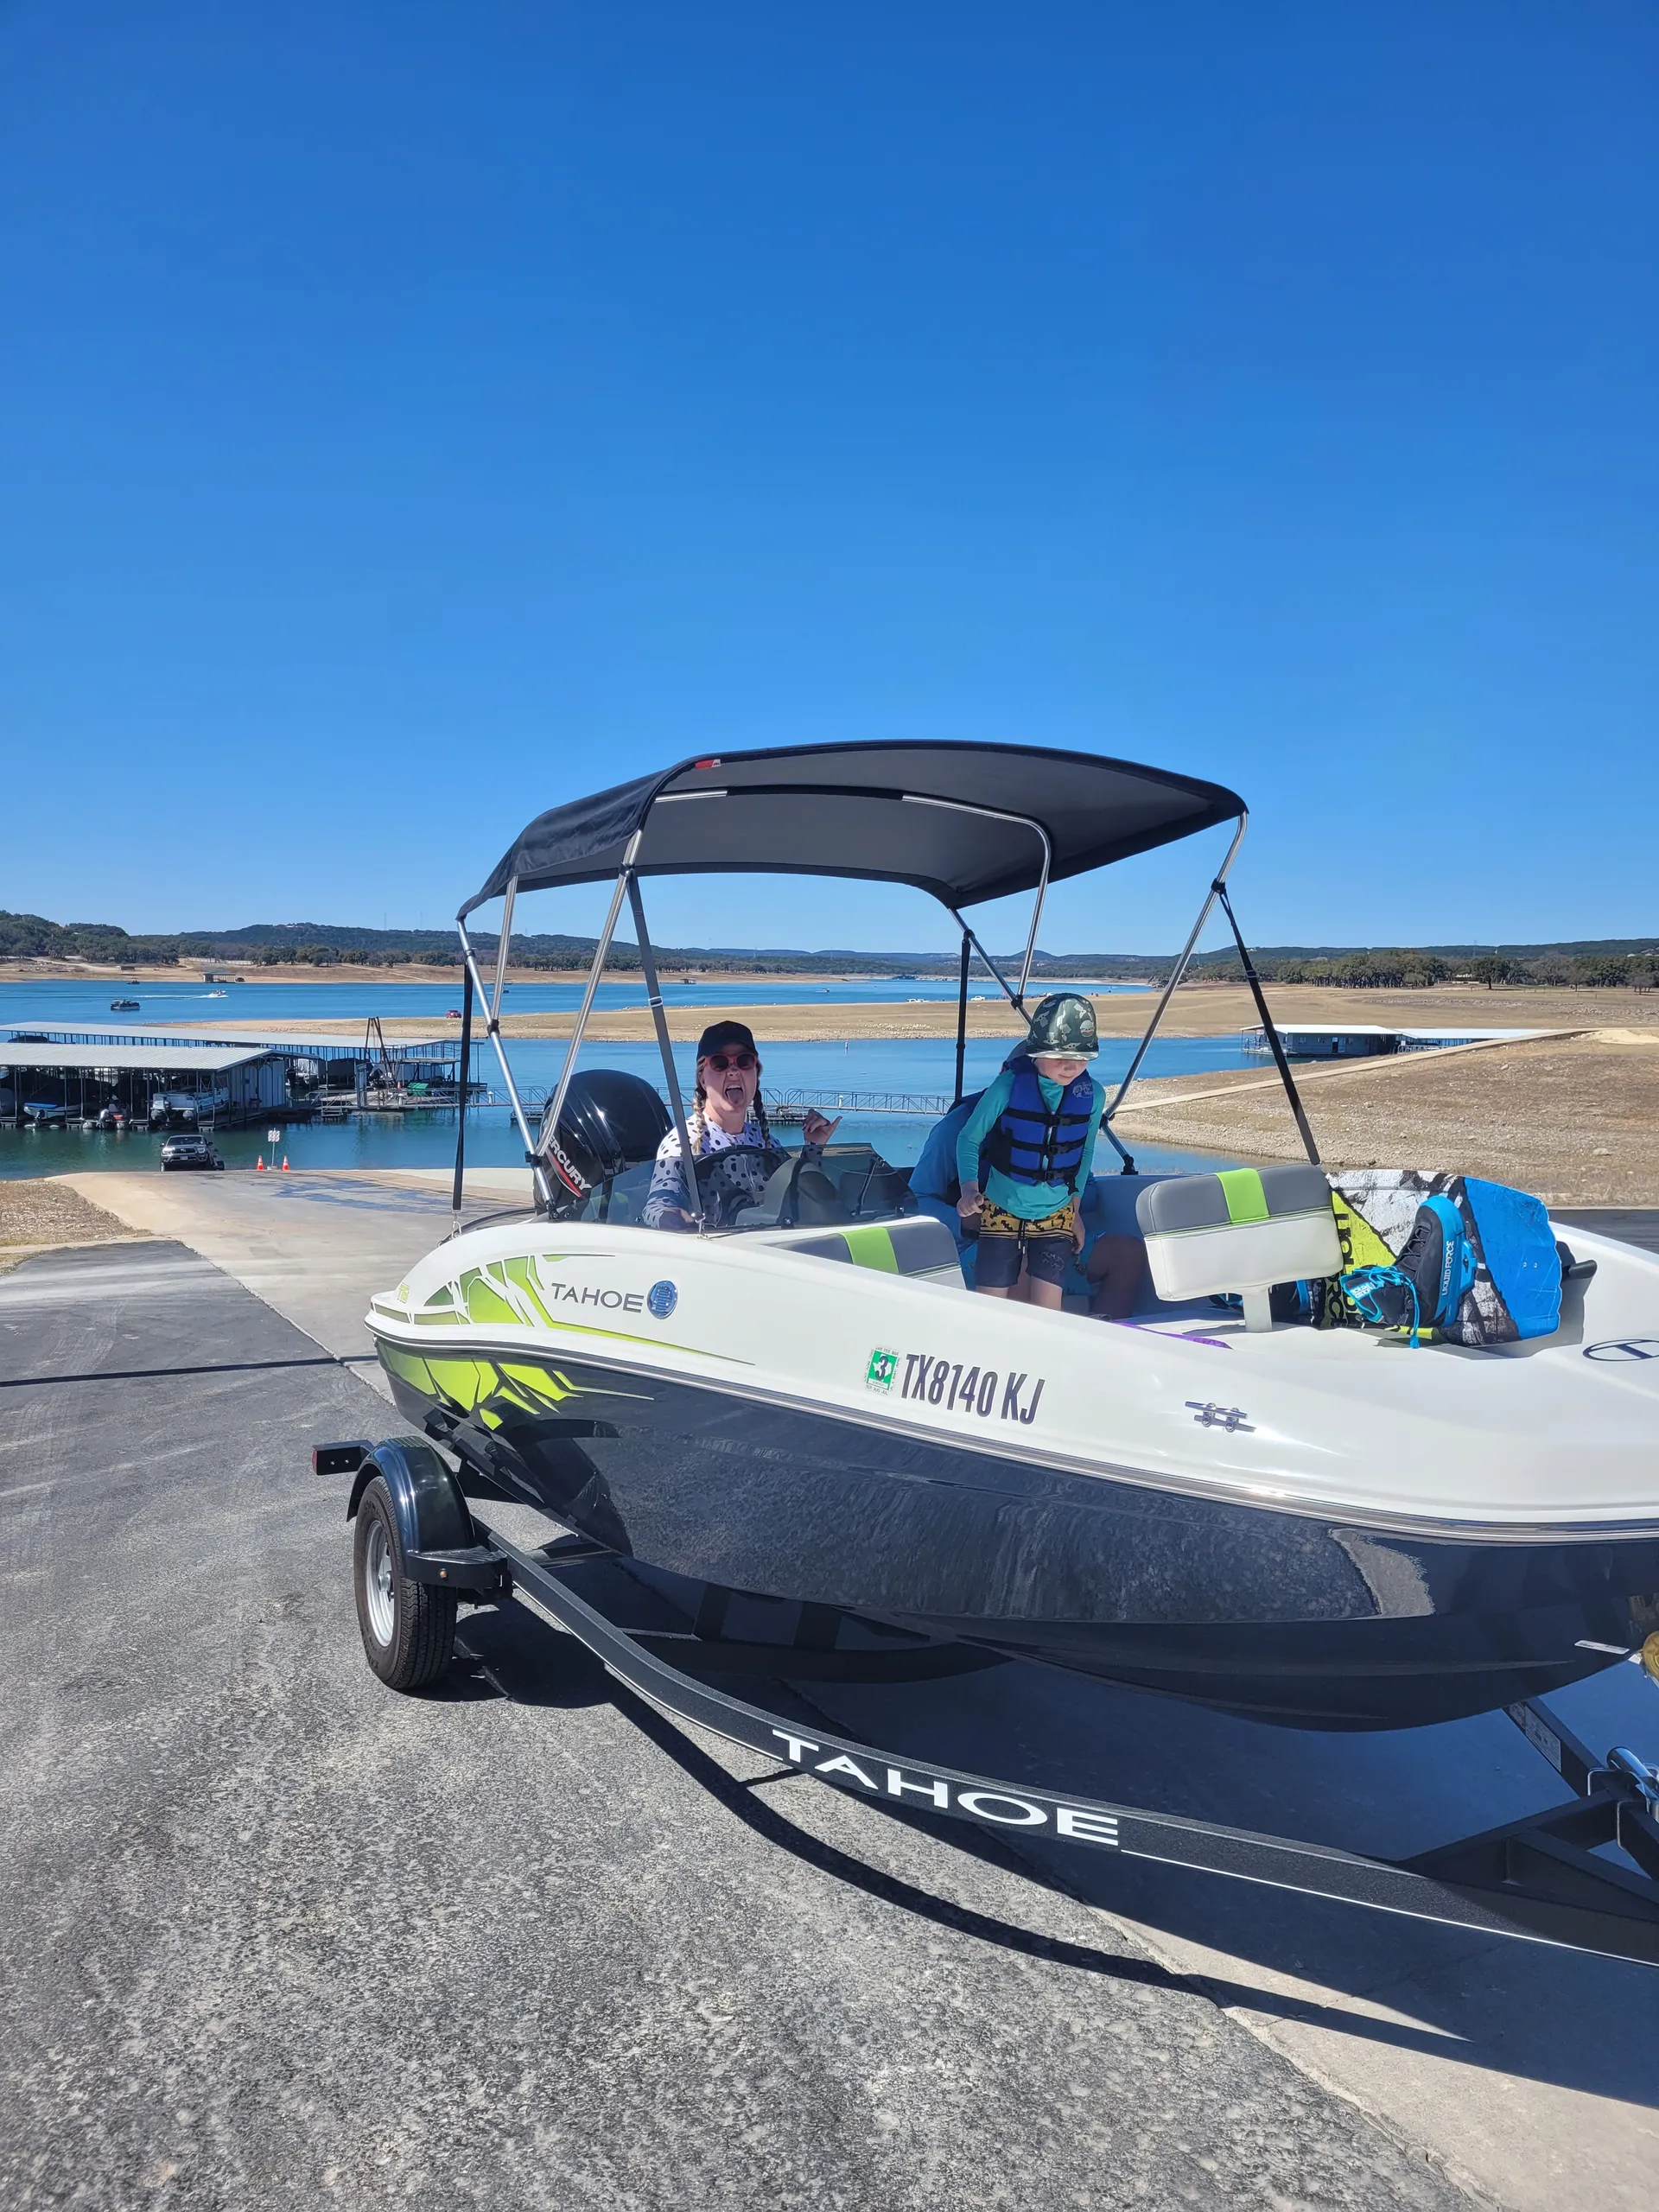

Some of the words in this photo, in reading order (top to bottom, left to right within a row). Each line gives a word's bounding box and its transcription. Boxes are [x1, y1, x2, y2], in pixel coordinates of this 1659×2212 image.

[548, 1135, 593, 1191] ERCURY
[1445, 1240, 1454, 1268] FORCE
[1441, 1268, 1452, 1296] LIQUID
[551, 1283, 645, 1313] TAHOE
[875, 1356, 888, 1382] 3
[901, 1353, 998, 1417] TX8140
[1000, 1372, 1046, 1425] KJ
[772, 1729, 1118, 1846] TAHOE
